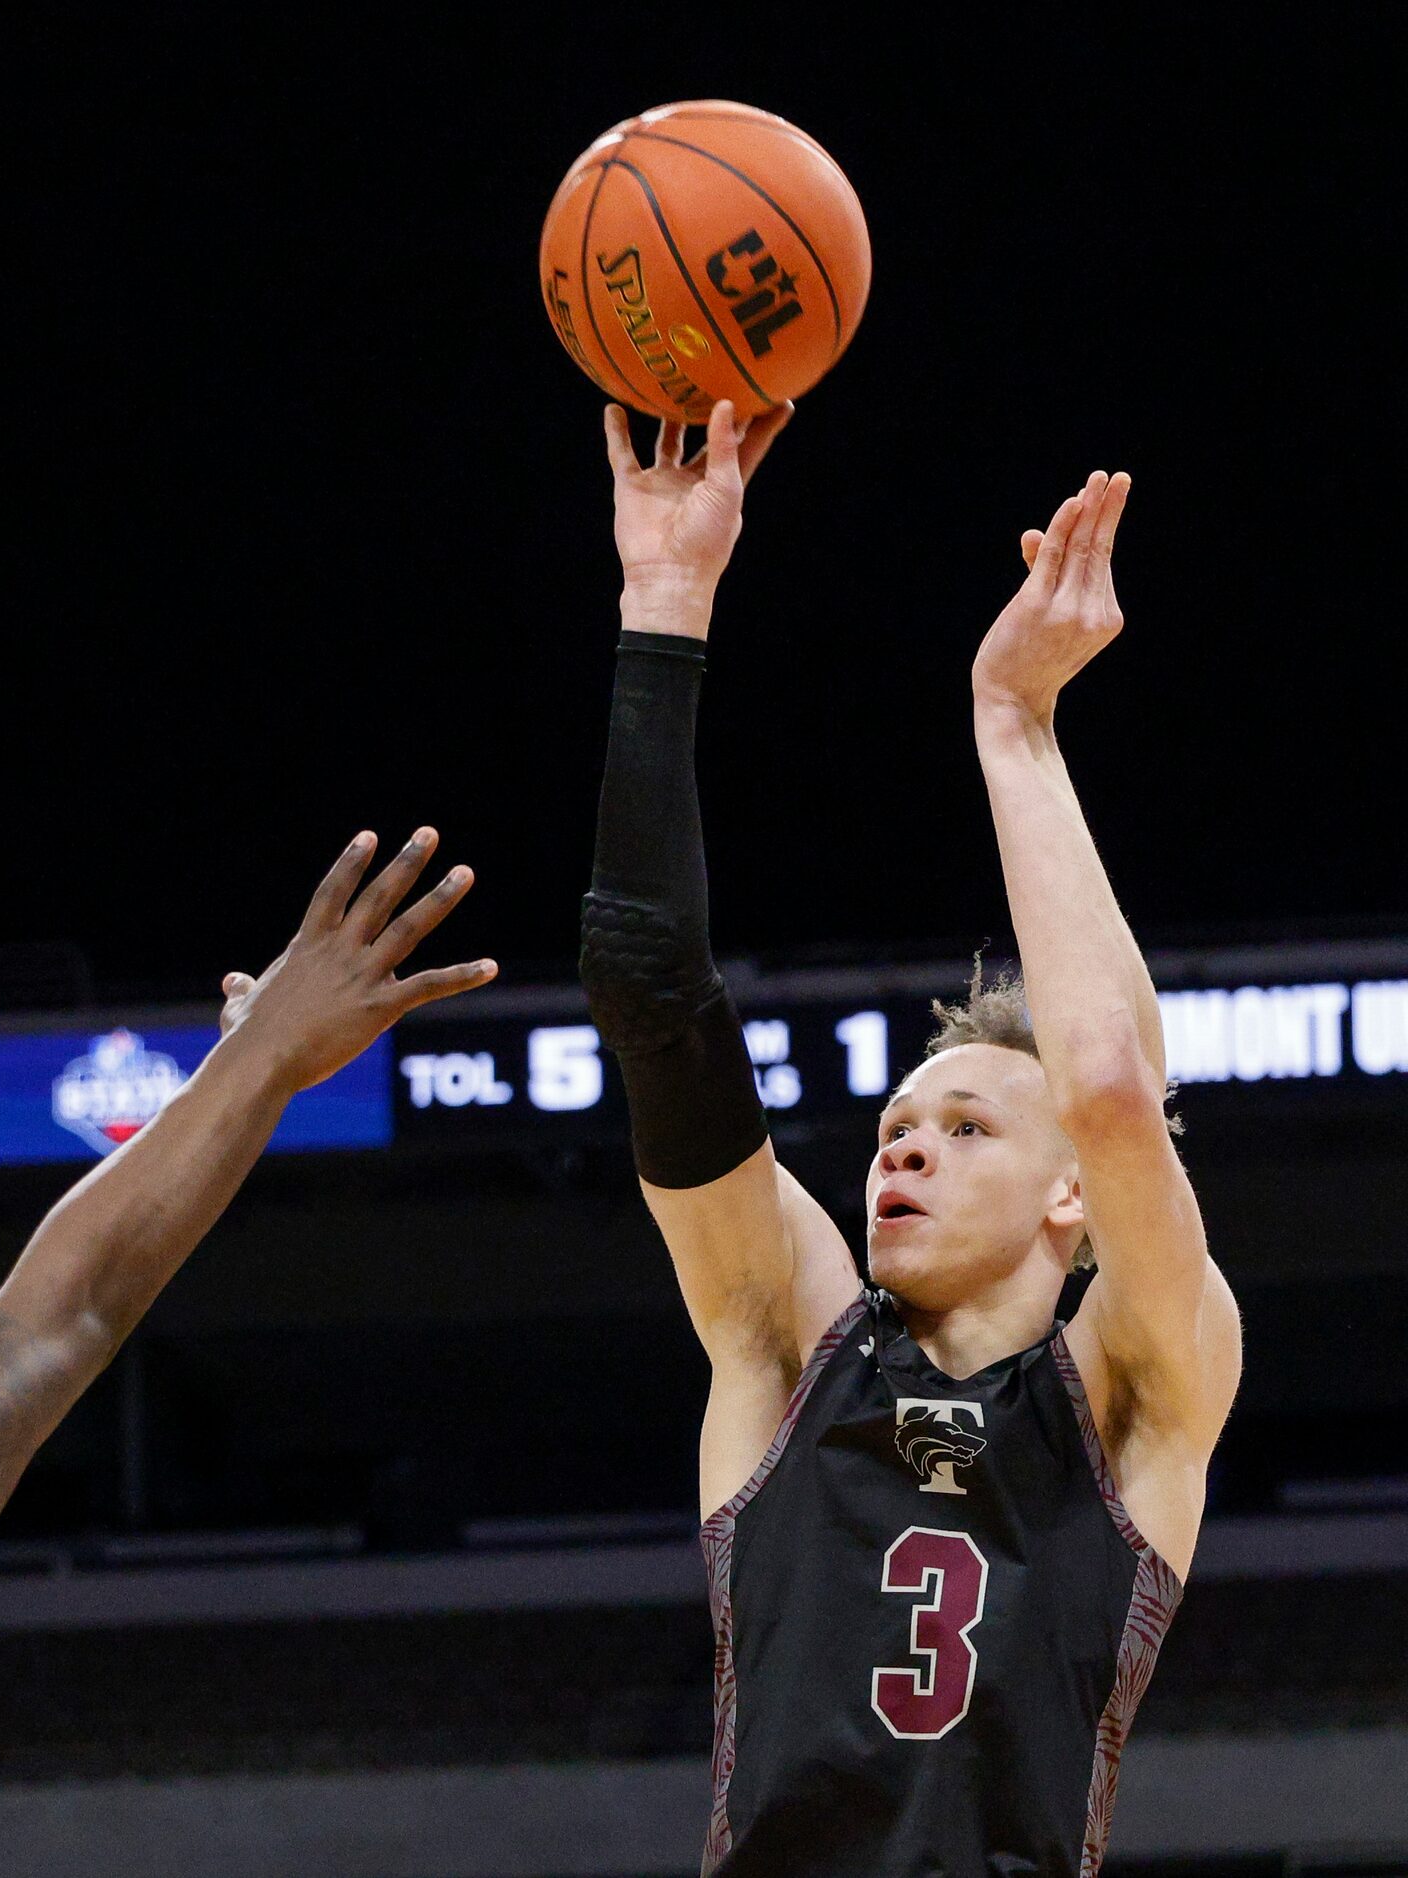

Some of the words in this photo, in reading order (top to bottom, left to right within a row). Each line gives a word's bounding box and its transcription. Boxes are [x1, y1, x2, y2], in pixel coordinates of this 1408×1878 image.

[400, 1052, 513, 1109] TOL
[527, 1024, 603, 1112] 5
[835, 1011, 889, 1097] 1
[894, 1397, 986, 1496] T
[870, 1525, 990, 1740] 3
